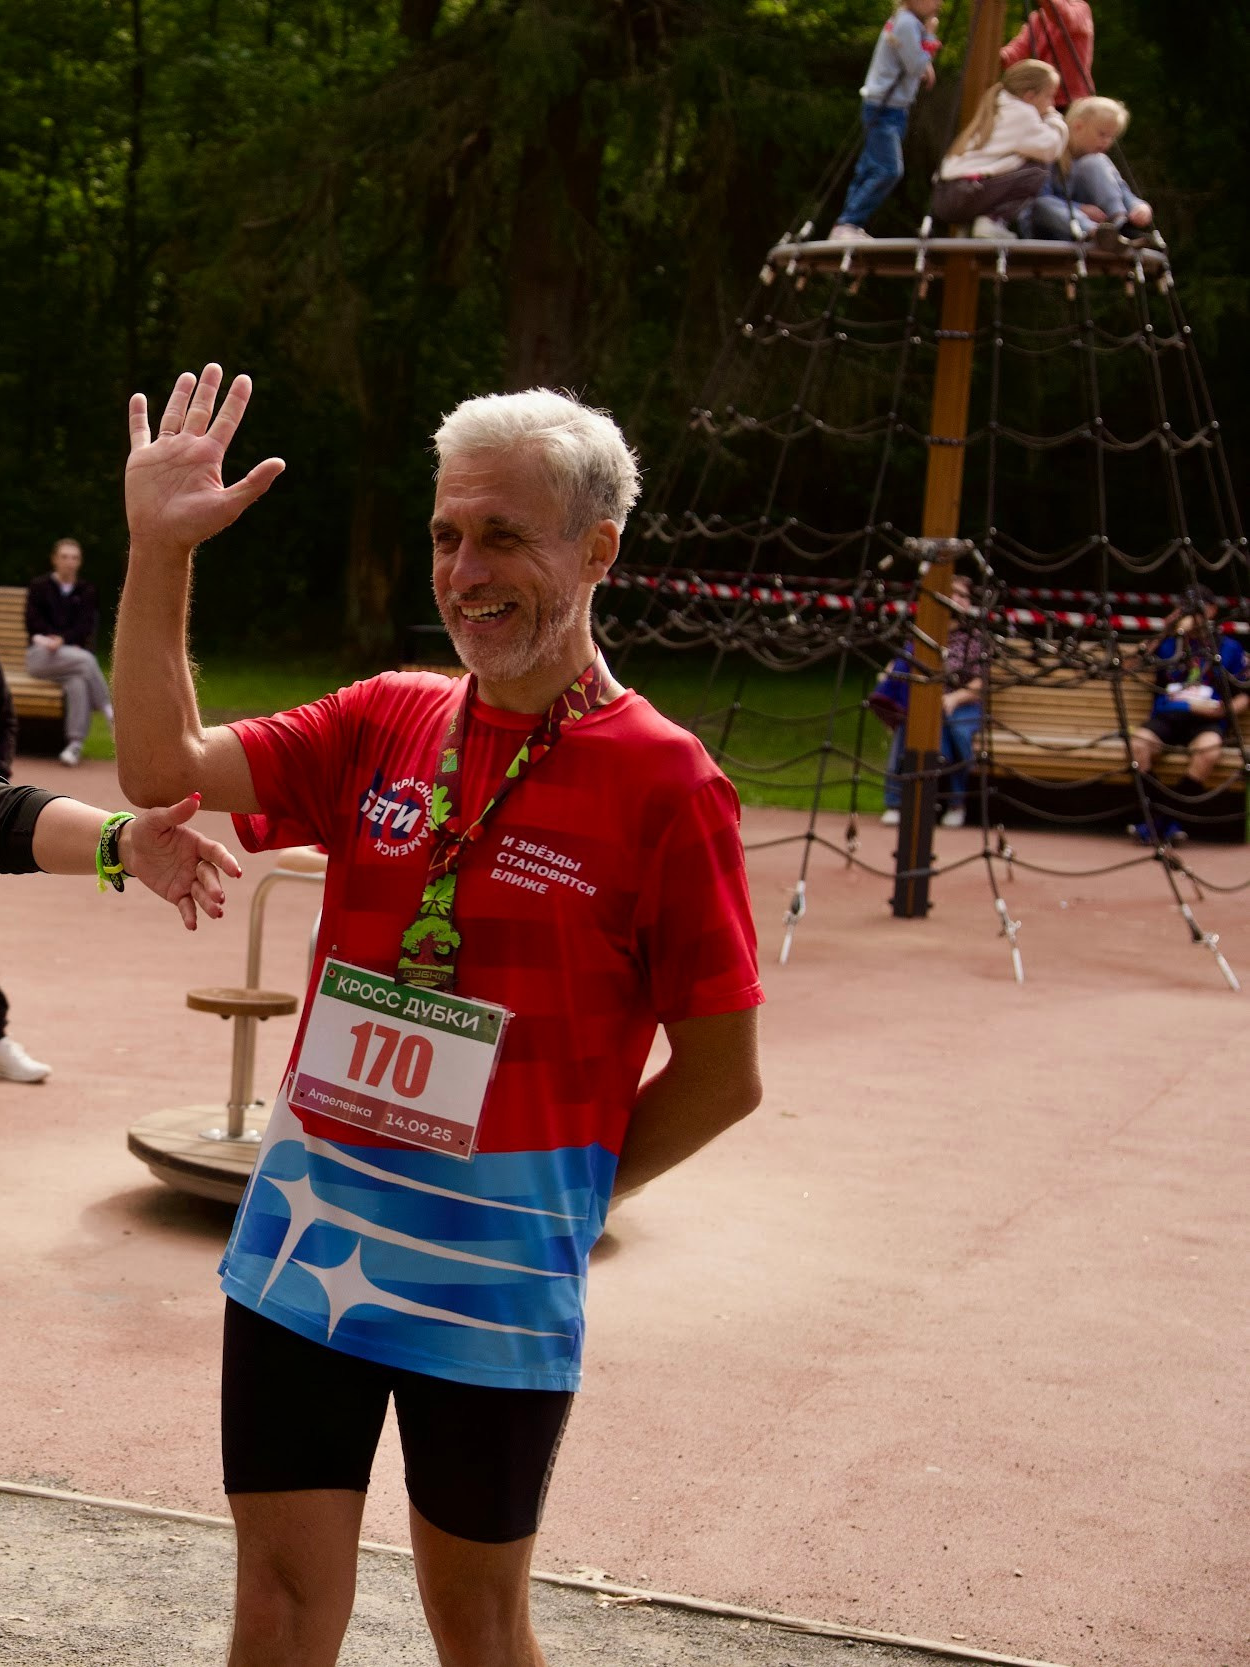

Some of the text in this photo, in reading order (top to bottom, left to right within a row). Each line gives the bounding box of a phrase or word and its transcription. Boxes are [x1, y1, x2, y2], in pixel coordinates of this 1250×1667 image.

[496, 852, 597, 896] СТАНОВЯТСЯ
[501, 835, 582, 872] И ЗВЁЗДЫ
[490, 868, 549, 895] БЛИЖЕ
[336, 975, 480, 1032] КРОСС ДУБКИ
[347, 1020, 434, 1099] 170
[307, 1087, 452, 1142] Апрелевка 14.09.25
